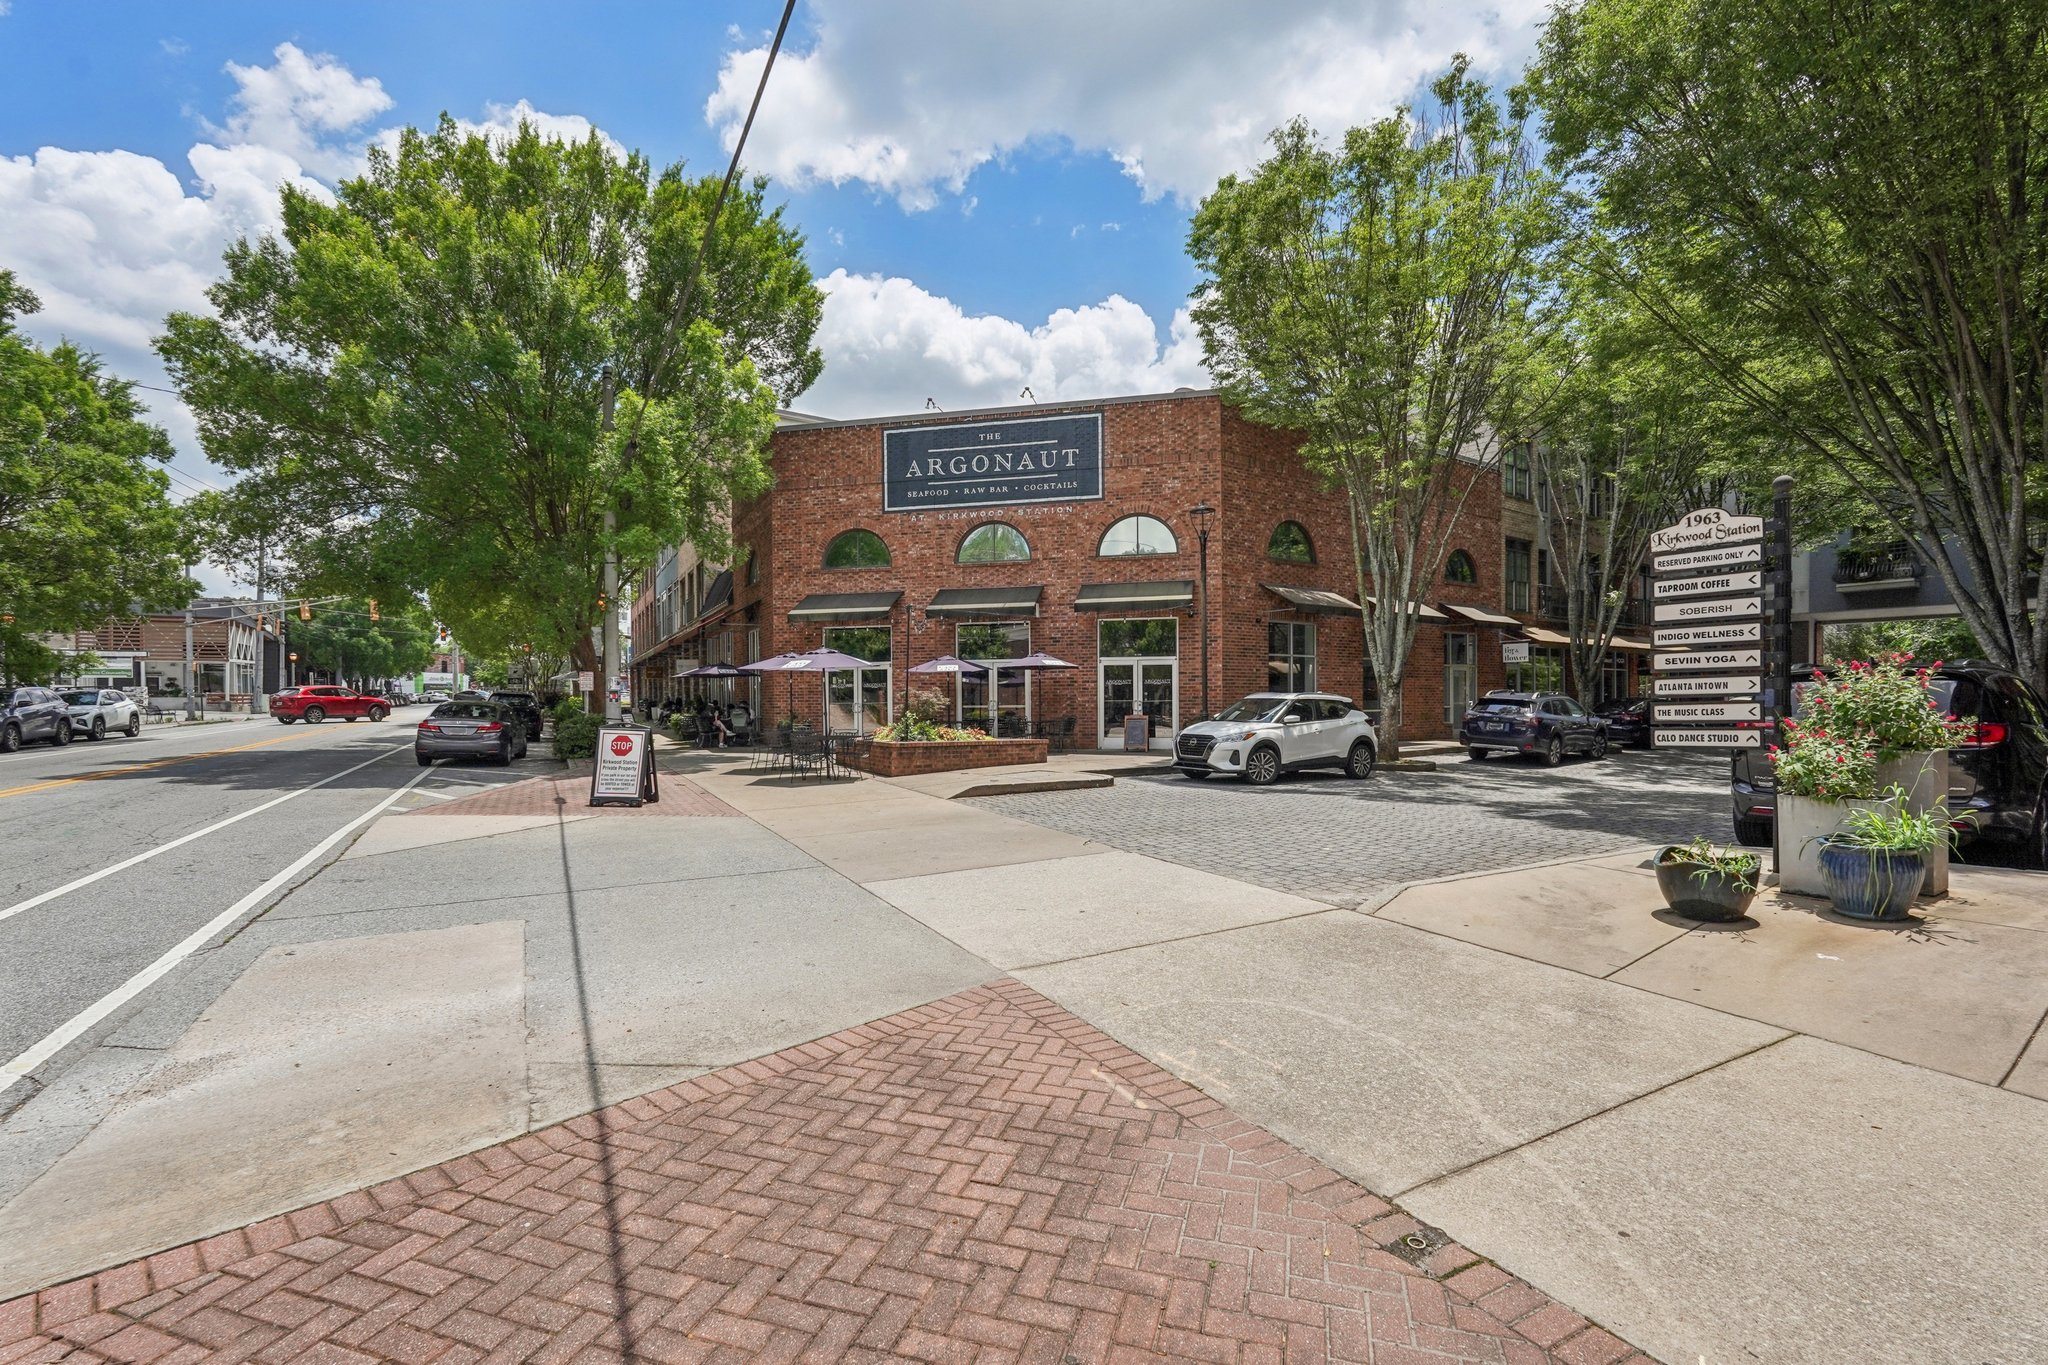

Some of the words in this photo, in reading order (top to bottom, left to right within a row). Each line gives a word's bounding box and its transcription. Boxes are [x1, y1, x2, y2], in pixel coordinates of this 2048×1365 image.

[979, 432, 1001, 441] THE
[905, 448, 1079, 478] ARGONAUT
[907, 489, 949, 498] SEAFOOD
[964, 487, 986, 495] RAW
[989, 485, 1009, 493] BAR
[1023, 481, 1079, 491] COCKTAILS
[911, 514, 925, 522] AT
[939, 509, 1004, 521] KIRKWOOD
[1017, 506, 1074, 516] STATION
[1685, 511, 1722, 528] 1963
[1652, 528, 1713, 548] Kirkwood
[1715, 523, 1761, 540] Station
[1657, 557, 1692, 568] RESERVED
[1692, 553, 1723, 564] PARKING
[1724, 550, 1744, 560] ONLY
[1657, 582, 1699, 594] TAPROOM
[1700, 579, 1730, 590] COFFEE
[1679, 604, 1733, 616] SOBERISH
[1657, 632, 1690, 641] INDIGO
[1692, 629, 1745, 639] WELLNESS
[1664, 656, 1701, 665] SEVIIN
[1704, 655, 1737, 664] YOGA
[1658, 683, 1693, 692] ATLANTA
[1694, 681, 1729, 691] INTOWN
[1657, 709, 1672, 717] THE
[1674, 708, 1698, 717] MUSIC
[1701, 708, 1725, 716] CLASS
[1656, 734, 1677, 743] CALO
[1678, 734, 1705, 743] DANCE
[1707, 734, 1739, 743] STUDIO
[611, 741, 632, 750] STOP
